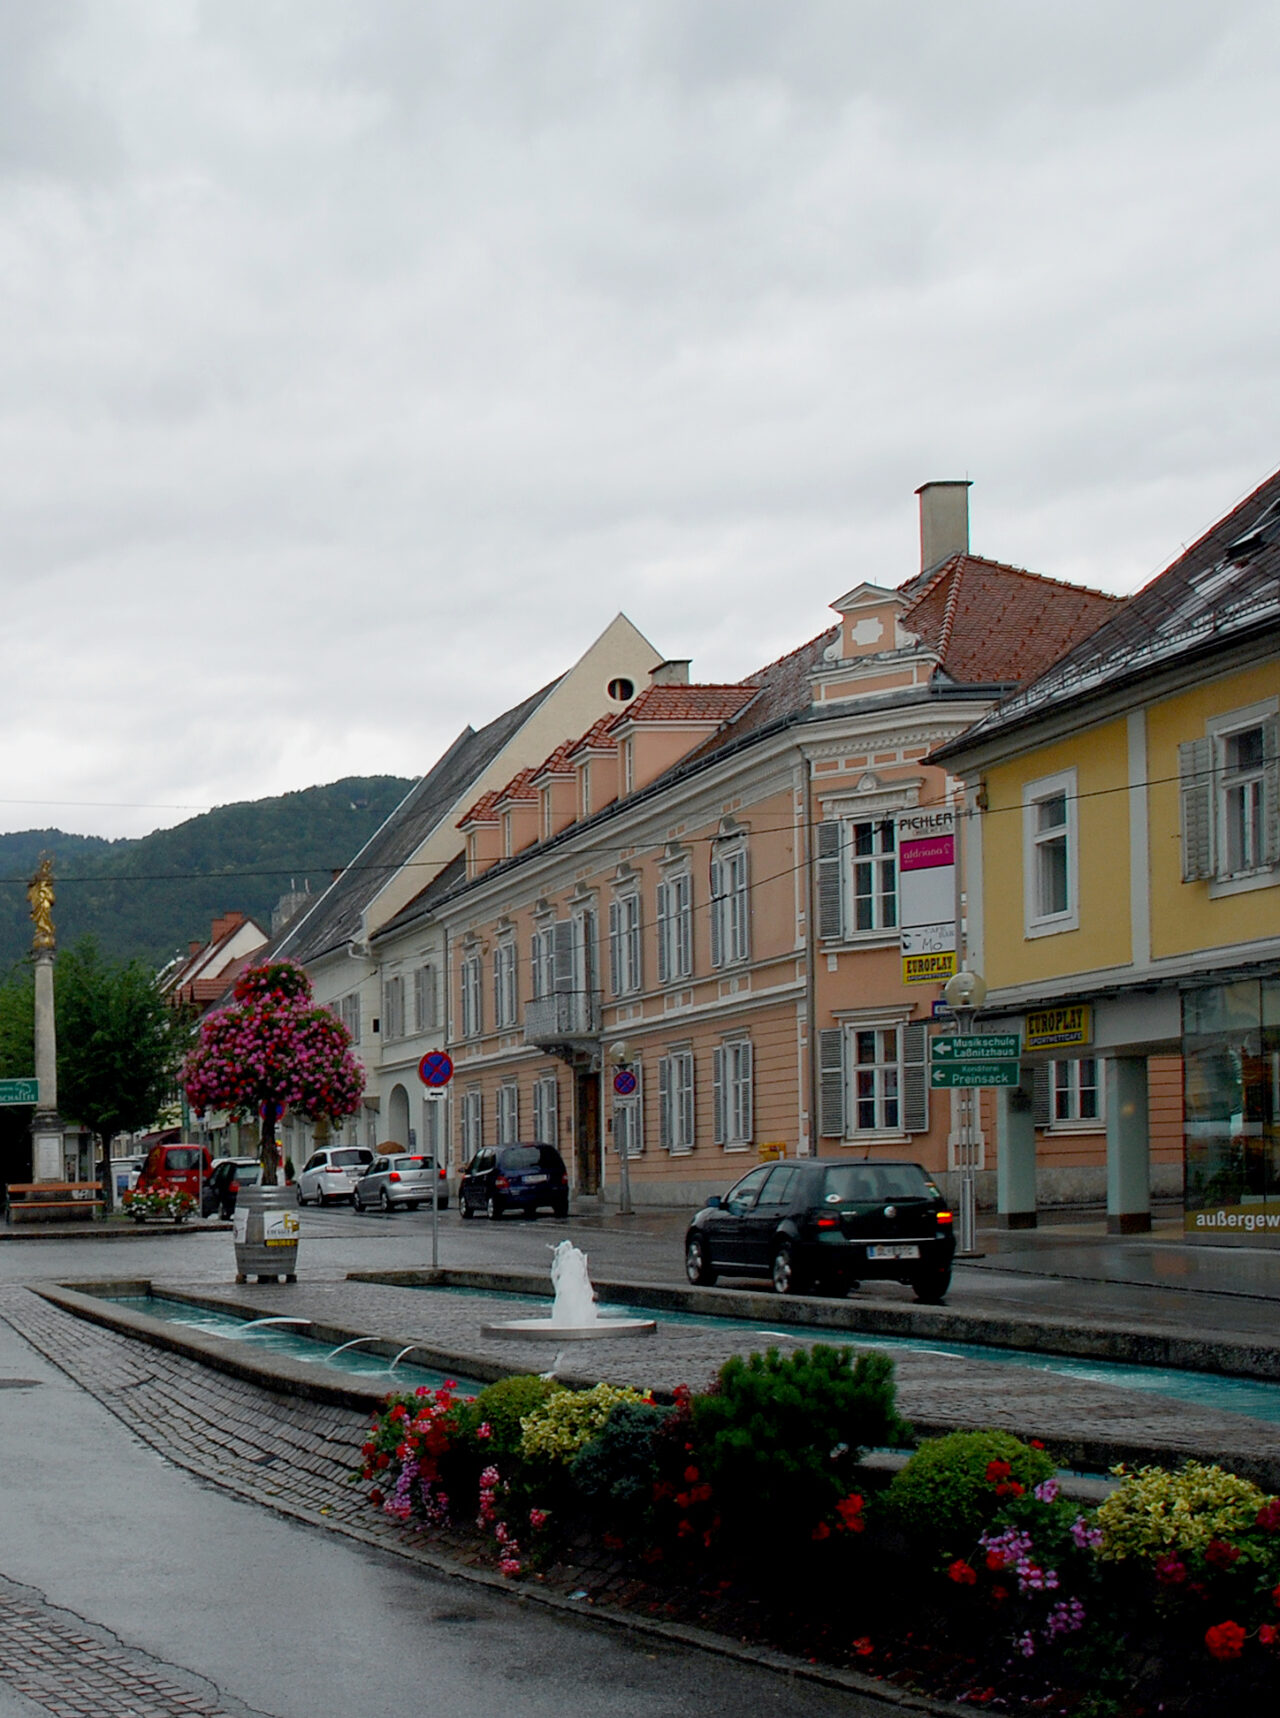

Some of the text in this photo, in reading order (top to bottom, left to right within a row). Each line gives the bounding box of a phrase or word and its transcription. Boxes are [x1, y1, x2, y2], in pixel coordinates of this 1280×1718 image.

[900, 813, 952, 831] PICHLER
[907, 956, 952, 973] EUROPLAY
[1028, 1008, 1082, 1035] EUROPLAY
[953, 1037, 1016, 1048] Musikschule
[954, 1049, 1014, 1058] Laßnitzhaus
[952, 1073, 1009, 1084] Preinsack
[1196, 1210, 1280, 1231] außergew
